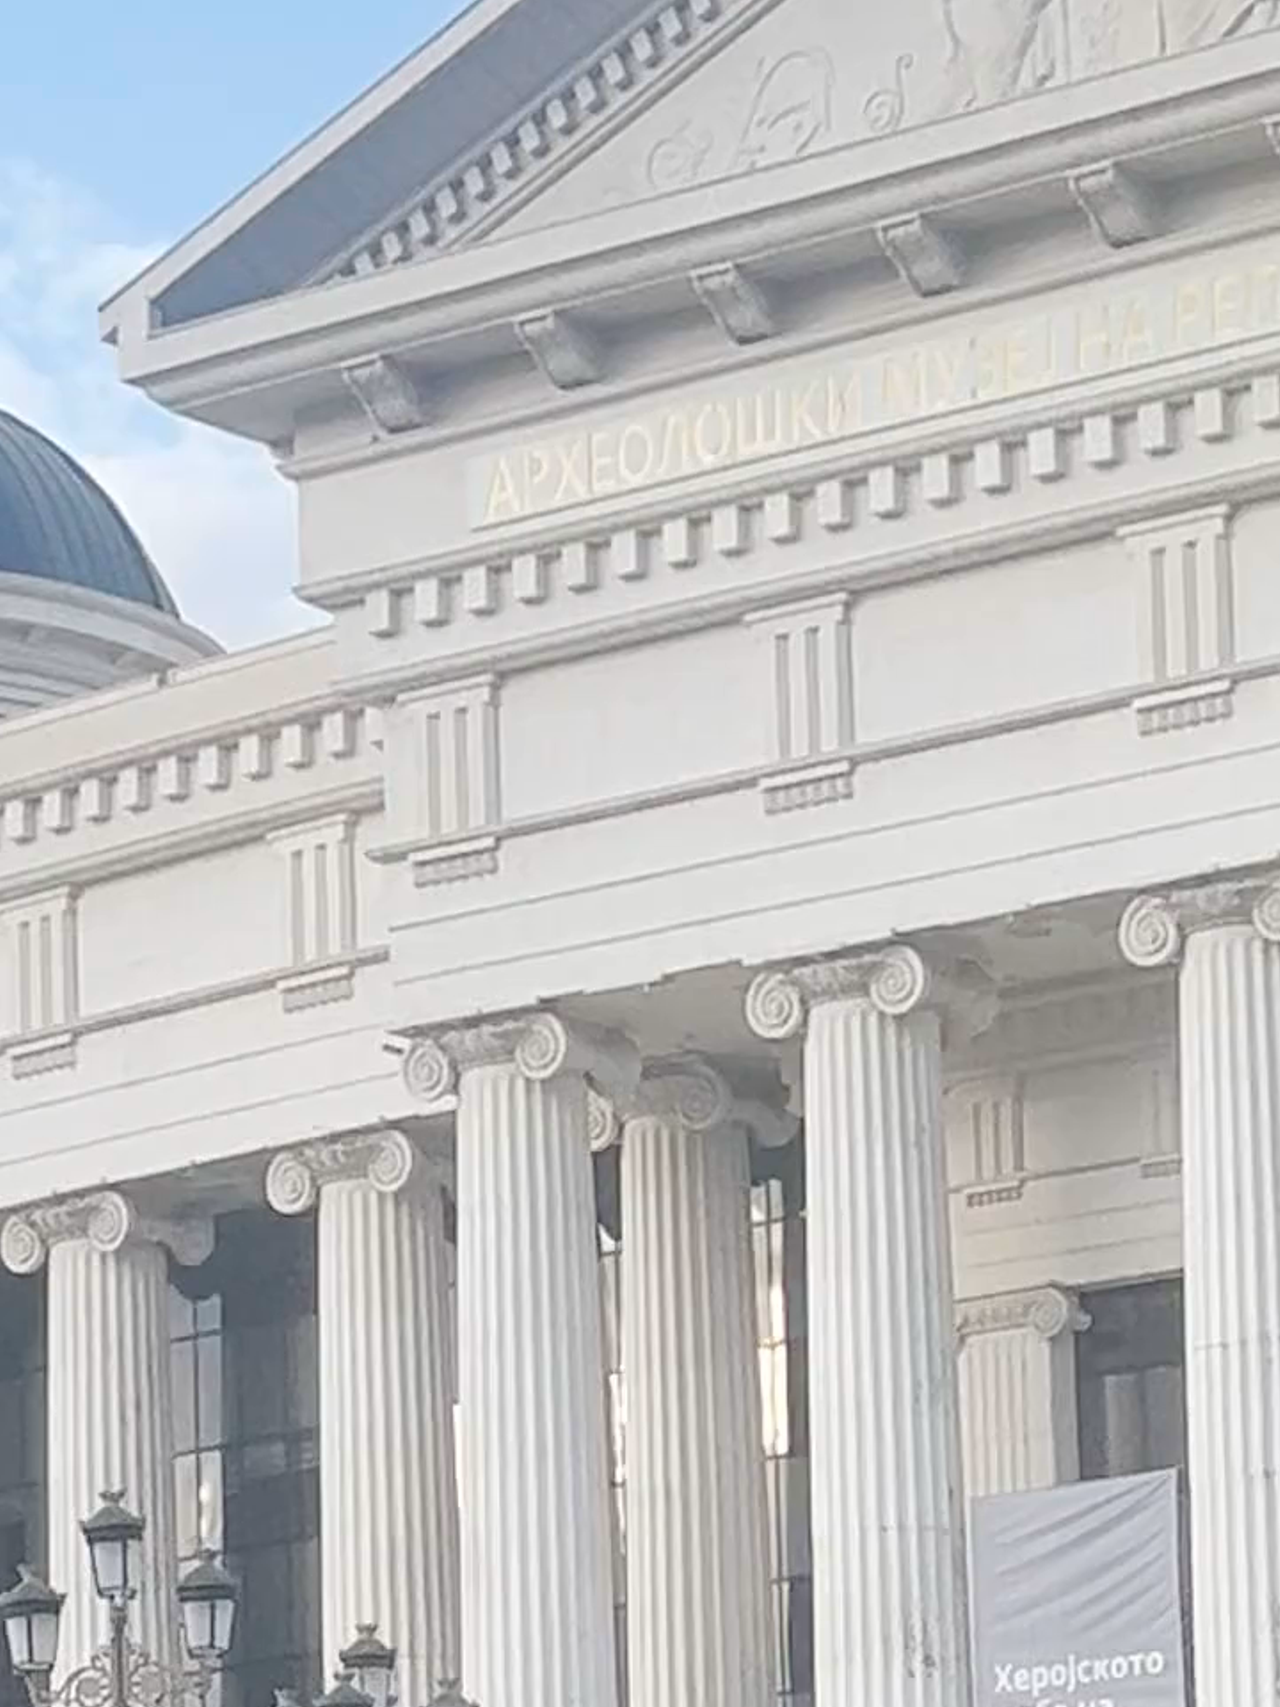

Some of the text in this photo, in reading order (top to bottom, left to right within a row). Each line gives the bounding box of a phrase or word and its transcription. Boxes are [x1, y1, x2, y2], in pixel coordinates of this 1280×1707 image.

[483, 372, 863, 519] АРХЕОЛОШКИ
[881, 319, 1060, 411] МУЗЕЈ
[1079, 299, 1153, 373] НА
[994, 1651, 1163, 1696] Херојското
